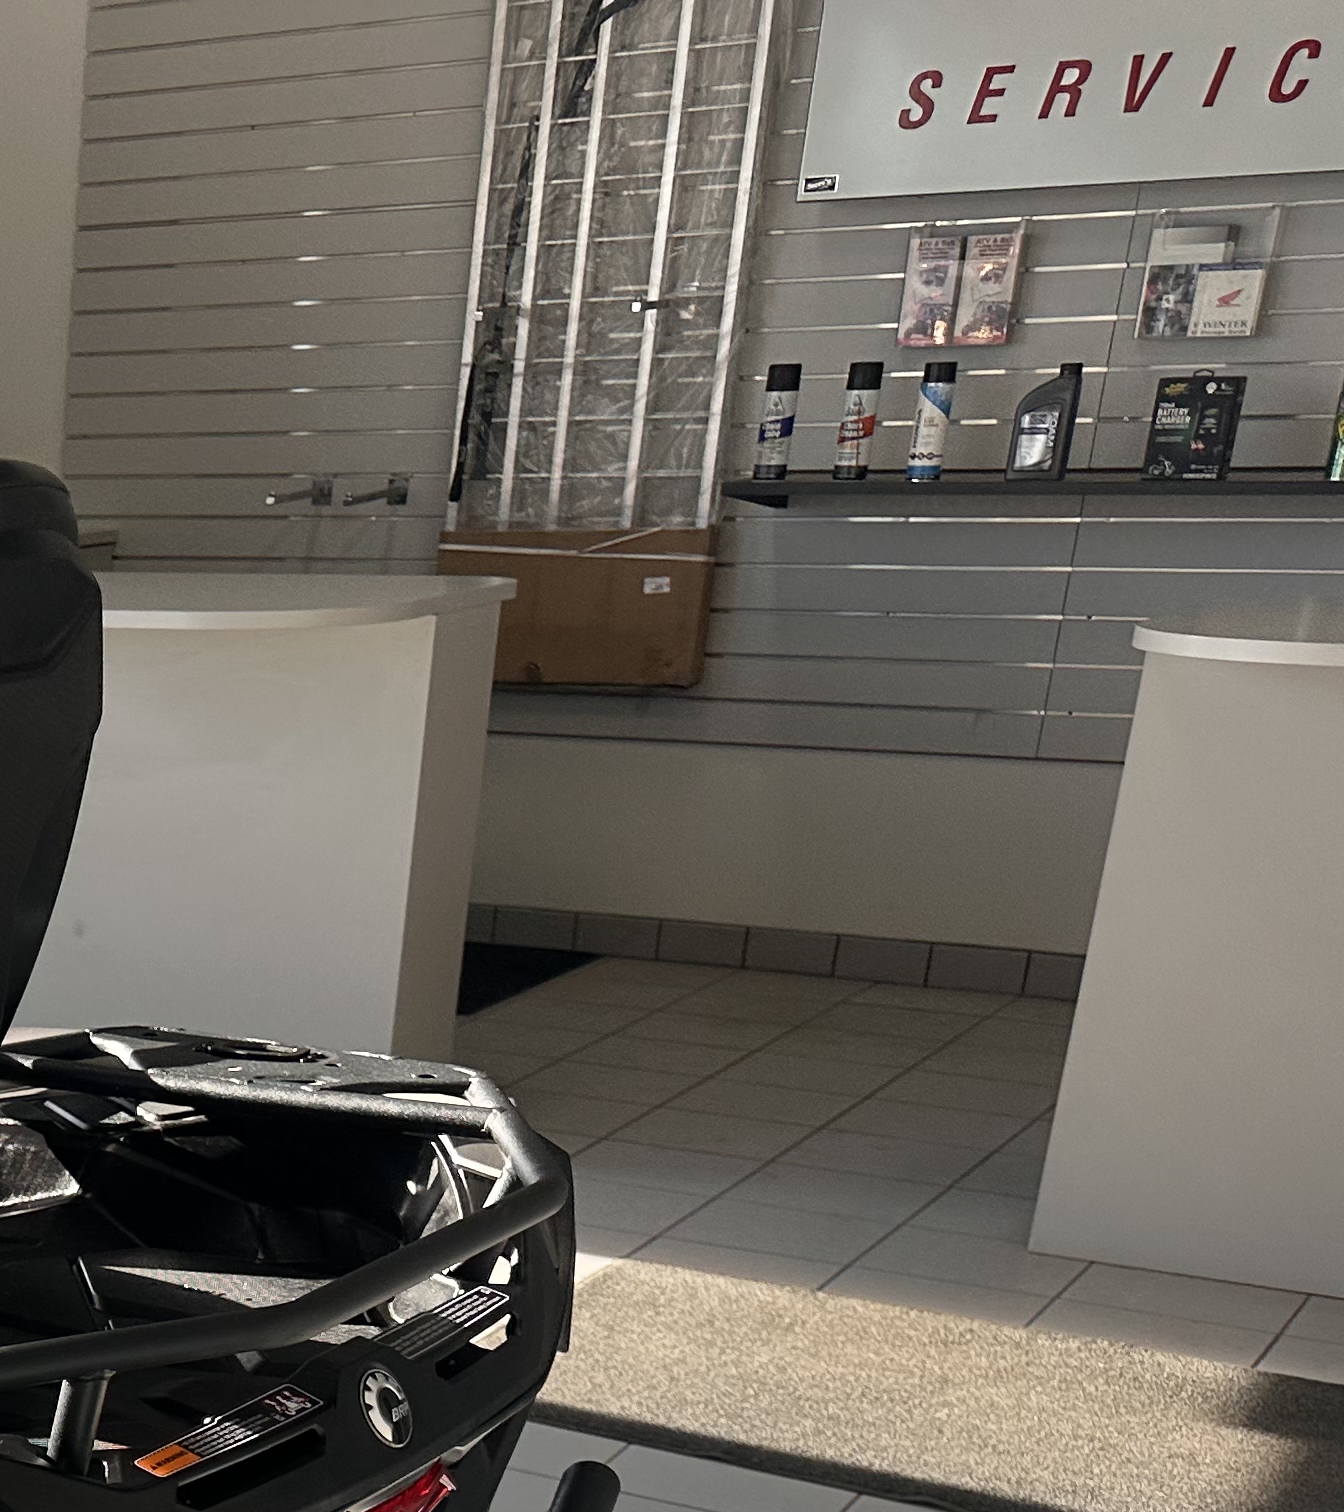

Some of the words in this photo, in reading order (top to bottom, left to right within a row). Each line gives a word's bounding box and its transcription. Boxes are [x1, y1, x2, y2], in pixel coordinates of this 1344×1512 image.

[898, 38, 1322, 130] SERVIC
[1157, 408, 1190, 417] BATTERY
[1155, 416, 1192, 425] CHARGER
